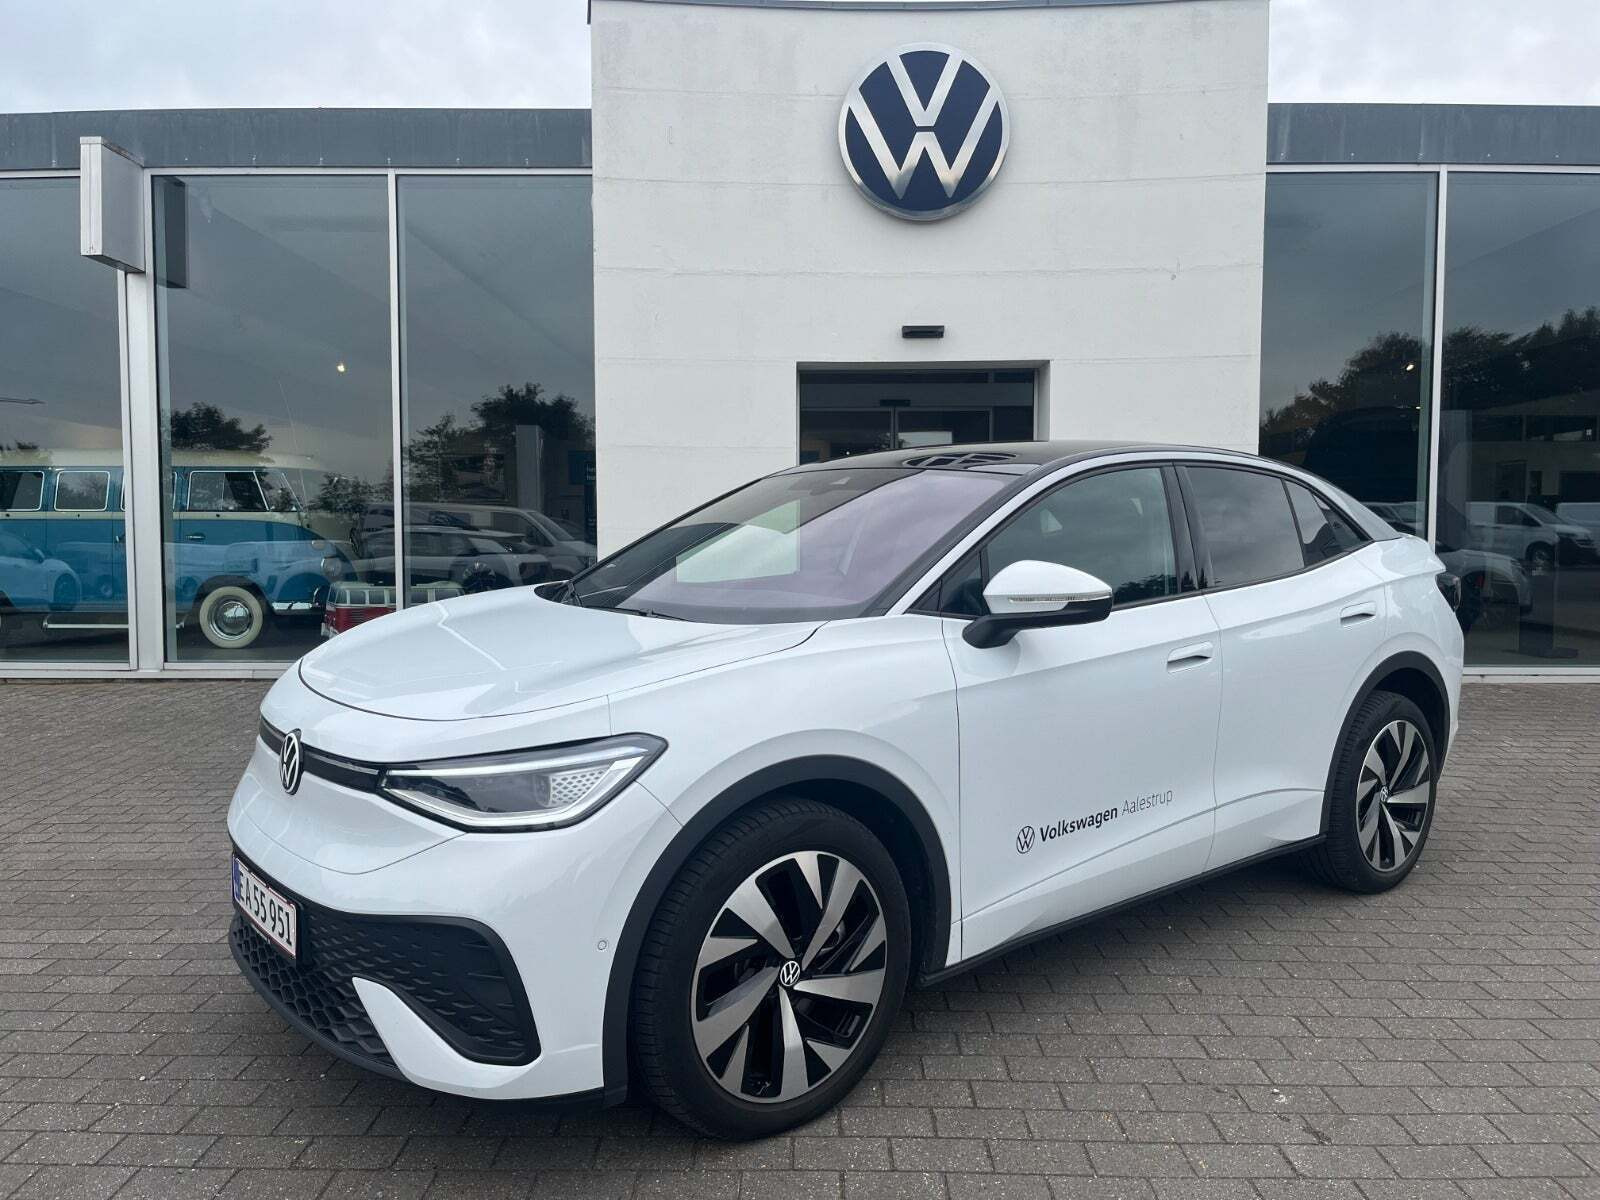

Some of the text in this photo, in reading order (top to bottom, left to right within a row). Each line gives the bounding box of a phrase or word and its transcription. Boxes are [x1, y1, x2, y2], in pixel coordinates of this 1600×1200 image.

[1039, 807, 1118, 842] Volkswagen
[1121, 789, 1174, 816] Aalestrup
[253, 884, 267, 923] 55
[269, 898, 292, 946] 951
